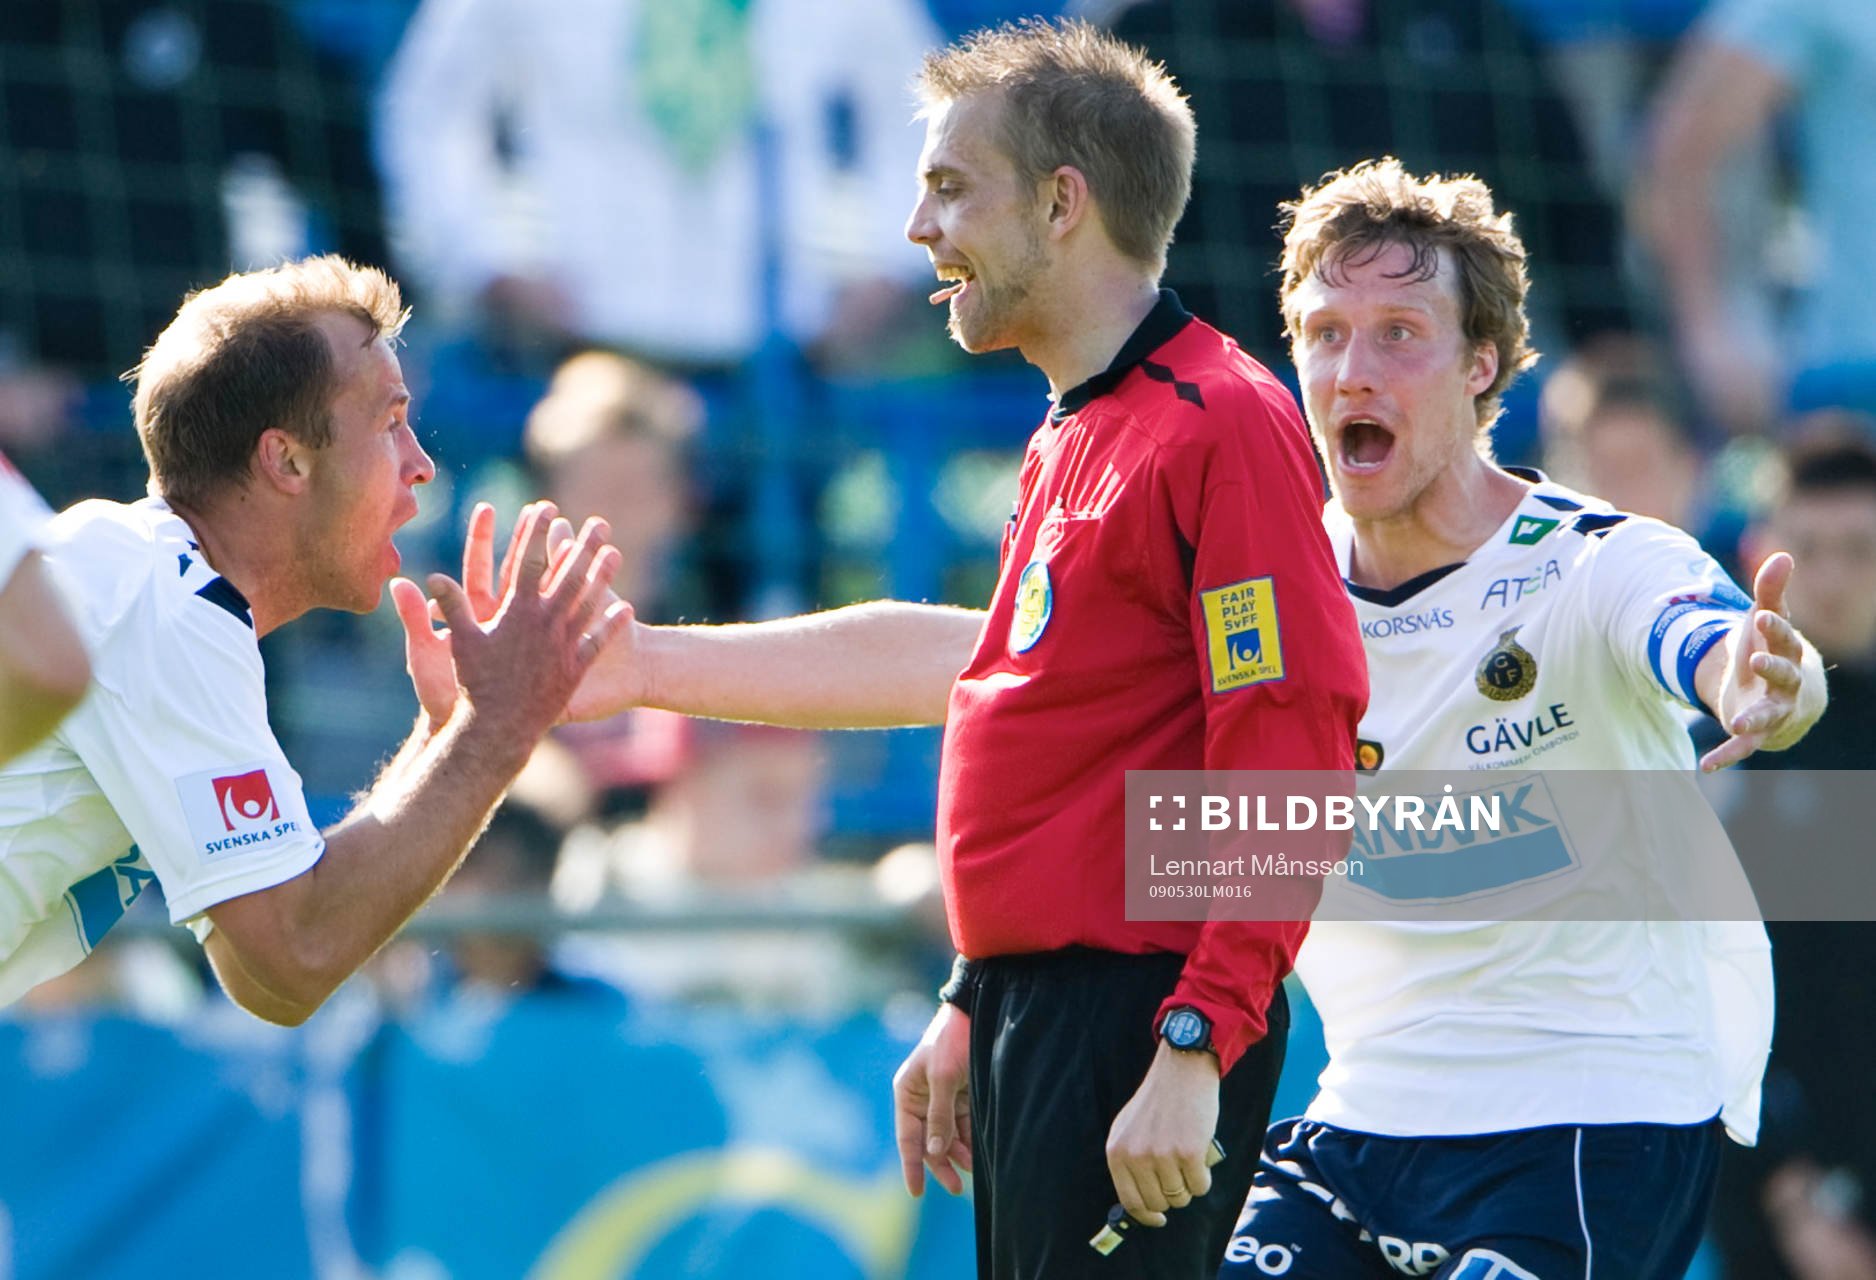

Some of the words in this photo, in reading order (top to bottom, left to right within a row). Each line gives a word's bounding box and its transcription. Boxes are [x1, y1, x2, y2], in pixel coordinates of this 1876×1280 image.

[1220, 587, 1255, 605] FAIR
[1222, 600, 1256, 618] PLAY
[1361, 607, 1454, 639] KORSNÄS
[1466, 703, 1575, 755] GÄVLE
[206, 830, 271, 855] SVENSKA
